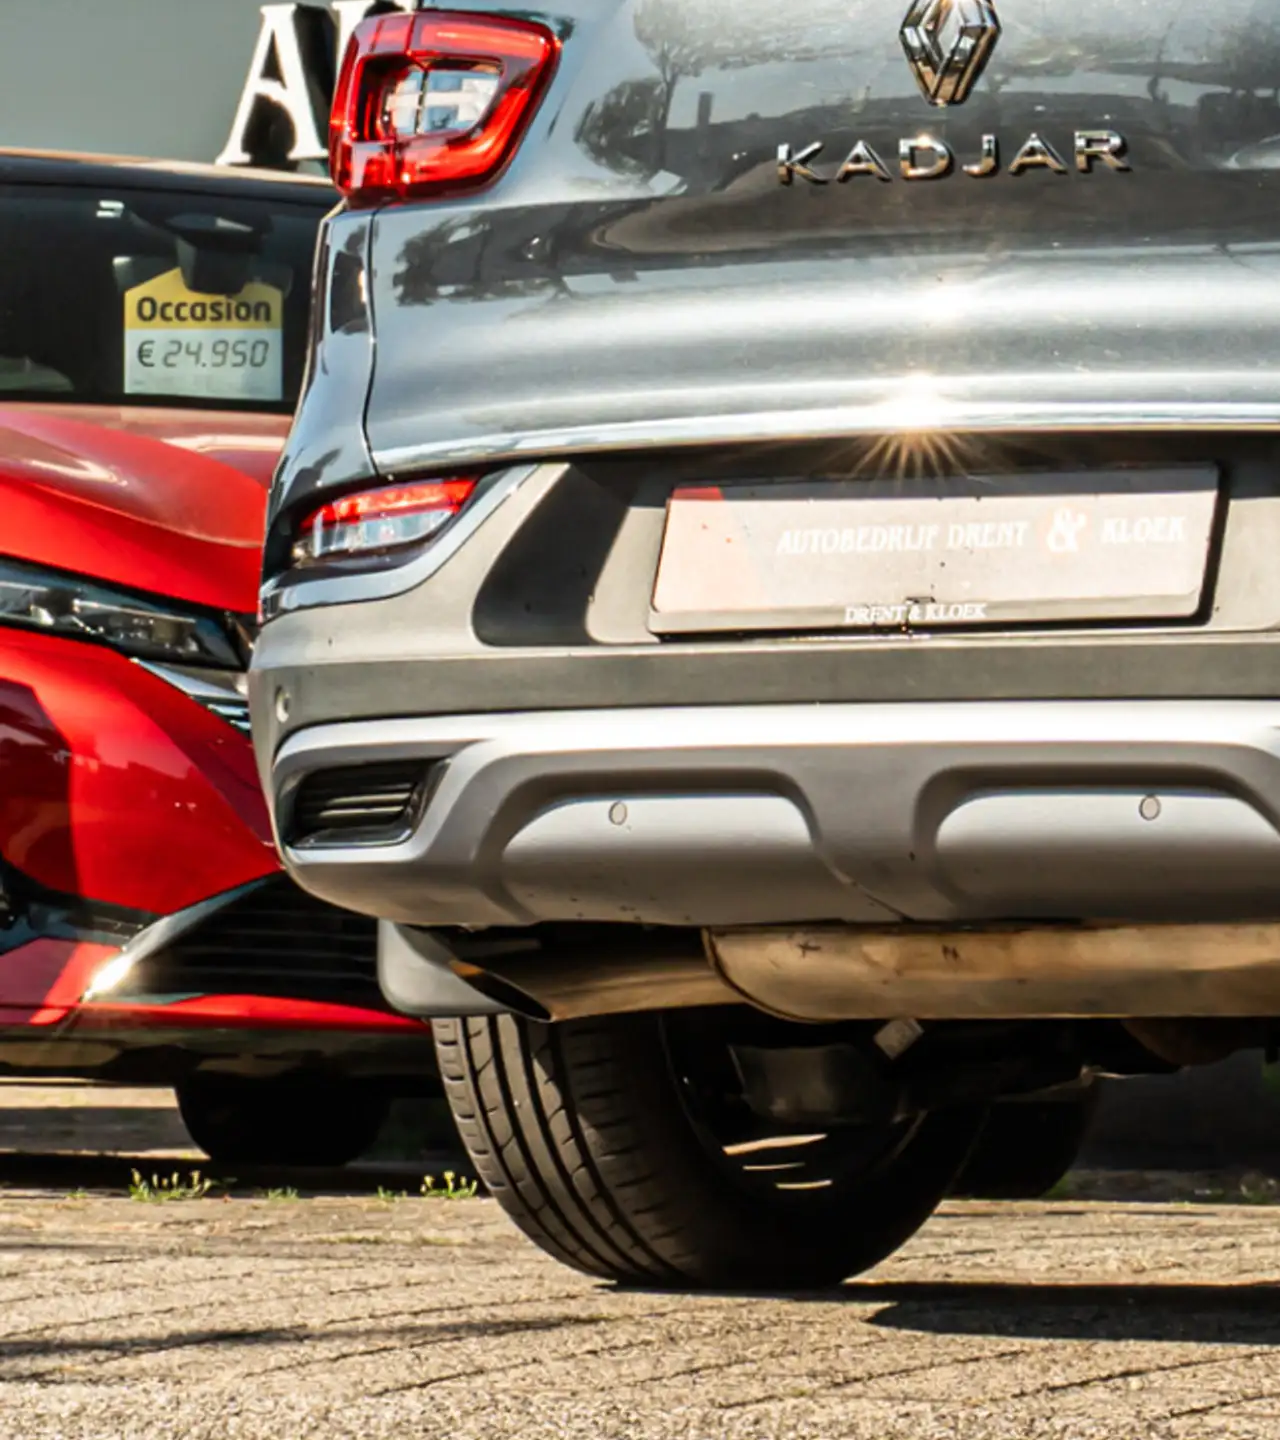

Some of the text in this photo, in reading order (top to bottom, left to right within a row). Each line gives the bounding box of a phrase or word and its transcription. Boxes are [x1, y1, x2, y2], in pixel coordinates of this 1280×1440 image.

[776, 129, 1130, 185] KADJAR
[137, 297, 272, 322] Occasion
[162, 339, 270, 368] 24.950
[947, 521, 1028, 549] DRENT
[1046, 506, 1087, 553] &
[1101, 516, 1186, 544] KLOEK
[845, 605, 906, 624] DRENT
[925, 602, 988, 620] KLOEK
